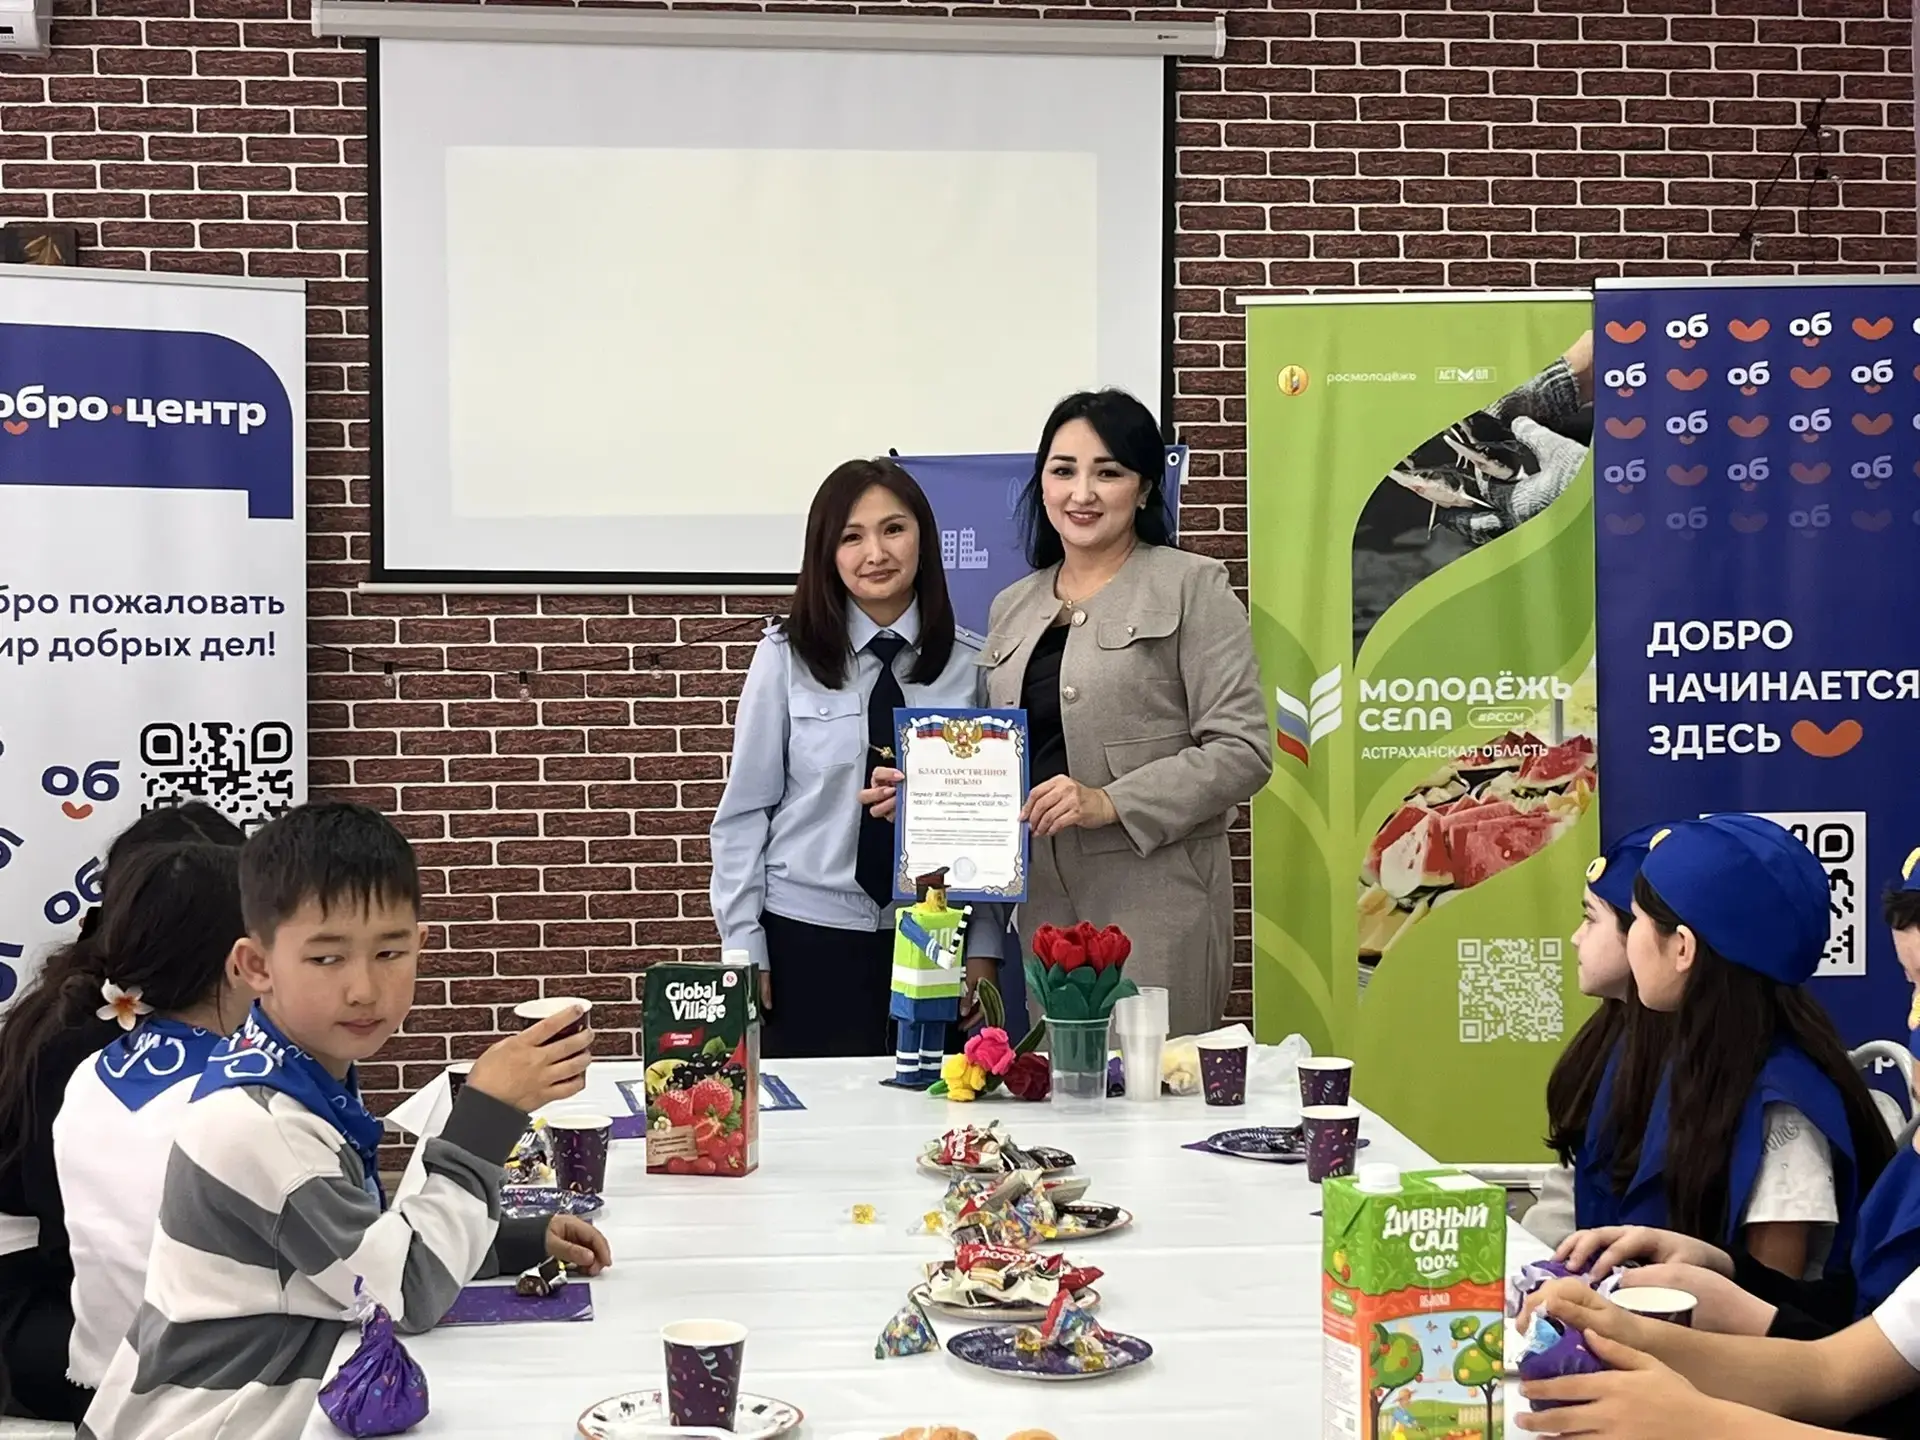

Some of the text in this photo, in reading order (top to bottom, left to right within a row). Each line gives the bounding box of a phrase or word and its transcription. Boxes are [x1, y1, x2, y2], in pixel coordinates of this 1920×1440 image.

[1666, 311, 1832, 338] об об
[1604, 359, 1894, 388] об об об
[1666, 408, 1831, 434] об об
[70, 593, 285, 615] пожаловать
[49, 627, 191, 665] добрых
[200, 631, 276, 662] дел!
[1646, 619, 1793, 658] ДОБРО
[1360, 670, 1572, 705] МОЛОДЁЖЬ
[1648, 669, 1920, 703] НАЧИНАЕТСЯ
[1359, 707, 1452, 732] СЕЛА
[1361, 743, 1549, 760] АСТРАХАНСКАЯ ОБЛАСТЬ
[1648, 723, 1781, 760] ЗДЕСЬ
[41, 760, 121, 801] об
[665, 980, 717, 1001] Global
[670, 1000, 726, 1022] Village
[1408, 1230, 1459, 1252] САД
[1415, 1255, 1459, 1272] 100%
